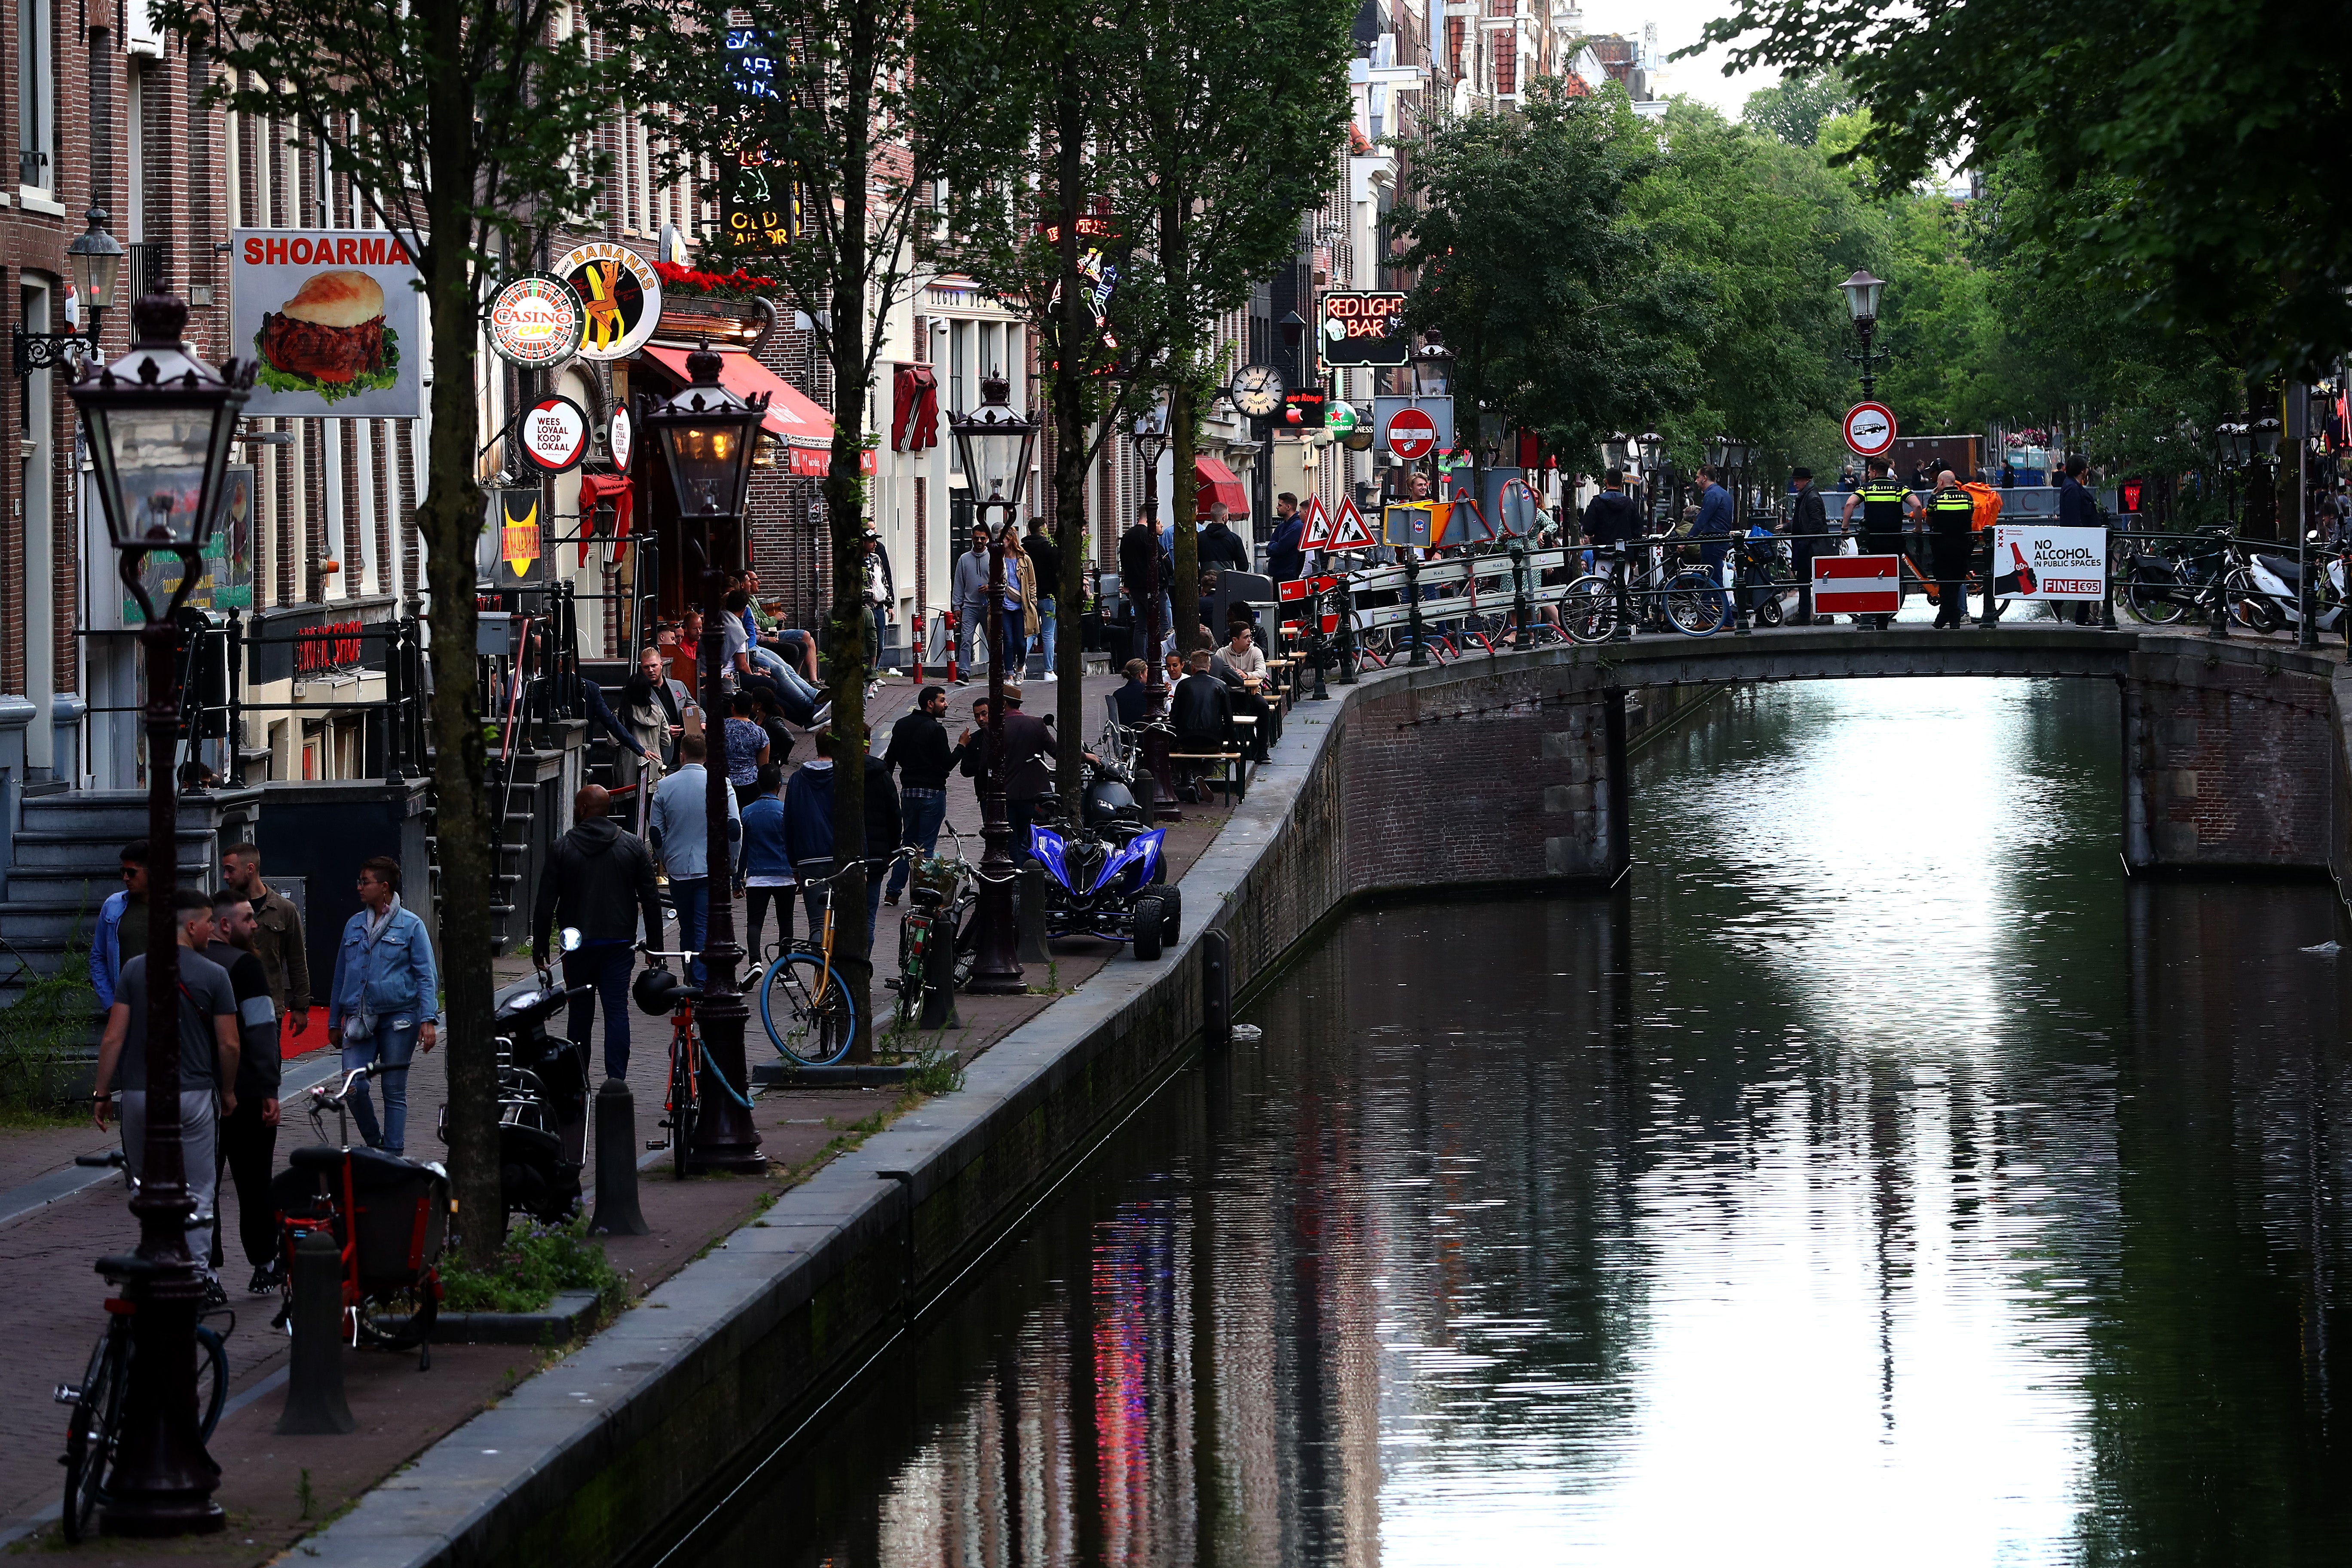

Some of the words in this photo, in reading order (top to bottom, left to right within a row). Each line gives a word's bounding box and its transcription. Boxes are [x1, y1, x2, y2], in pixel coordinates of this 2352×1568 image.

[243, 237, 410, 265] SHOARMA
[571, 244, 655, 291] BANANAS
[931, 290, 959, 306] LEGER
[1327, 298, 1359, 318] RED
[1362, 298, 1404, 316] LIGHT
[518, 325, 553, 336] City
[1348, 319, 1385, 338] BAR
[1247, 396, 1270, 405] SCHMIDT
[1301, 393, 1323, 404] Rouge
[537, 417, 560, 426] WEES
[537, 426, 569, 434] LOYAAL
[616, 431, 626, 439] LOYAAL
[537, 434, 561, 442] KOOP
[537, 442, 570, 451] LOKAAL
[616, 446, 627, 454] LOKAAL
[2034, 539, 2052, 550] NO
[2034, 548, 2093, 560] ALCOHOL
[2045, 580, 2076, 592] FINE
[2079, 582, 2098, 591] €95
[299, 625, 332, 671] EROTIC
[333, 620, 363, 665] SHOP
